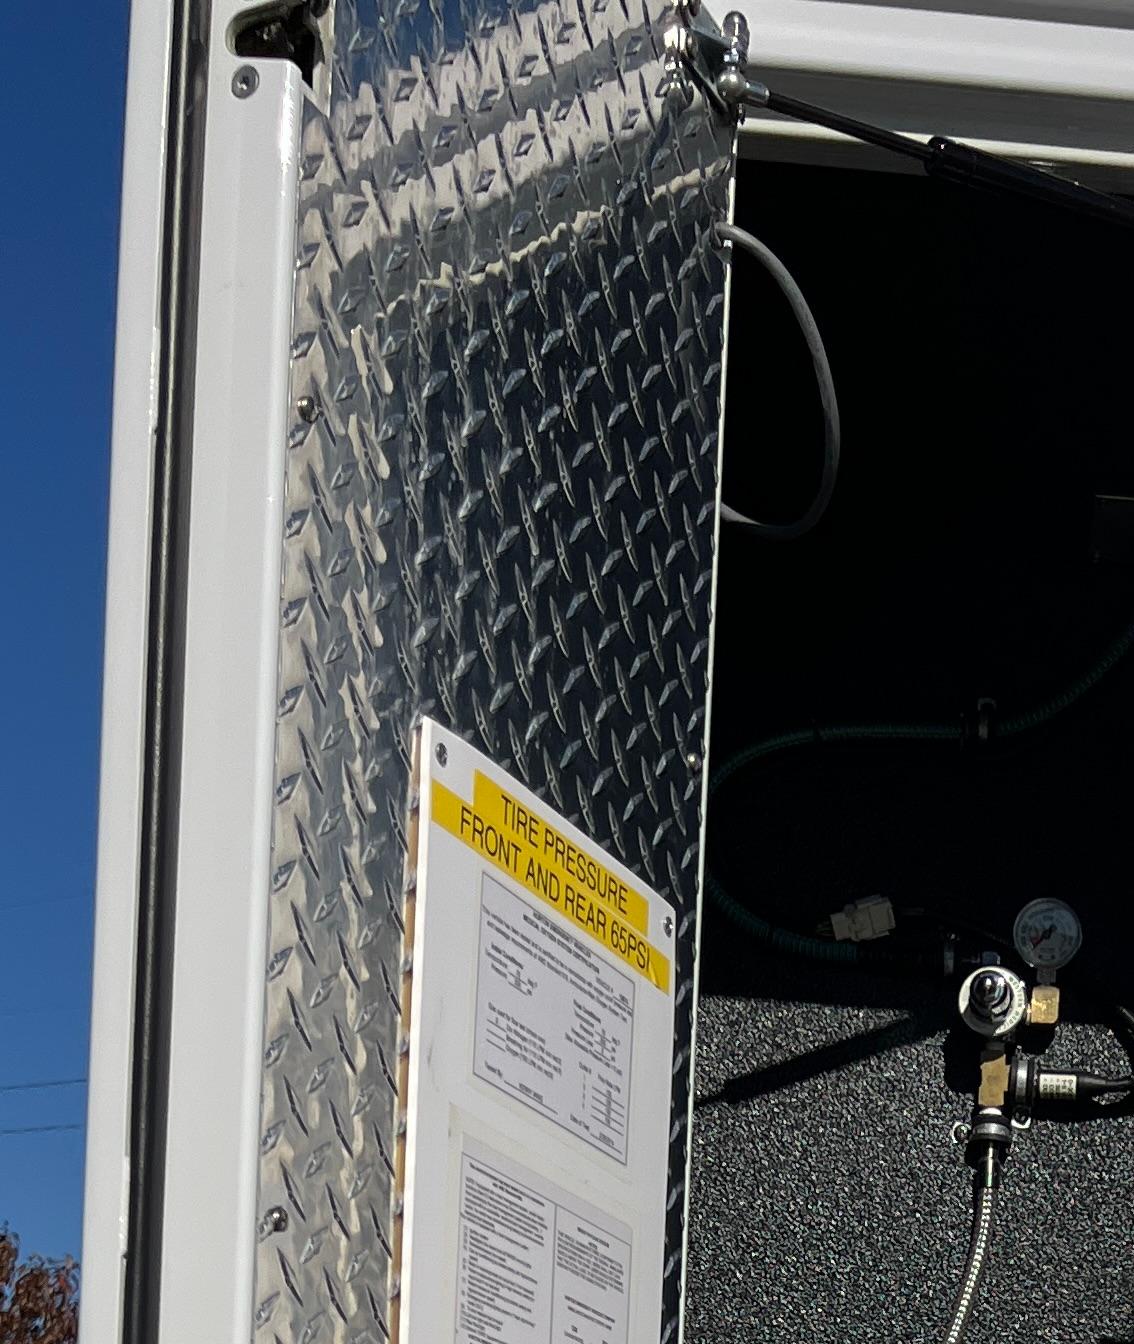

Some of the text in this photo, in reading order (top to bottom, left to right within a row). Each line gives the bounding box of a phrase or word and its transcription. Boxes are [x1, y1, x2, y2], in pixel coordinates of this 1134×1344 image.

[459, 805, 522, 873] FRONT
[525, 857, 560, 903] AND
[564, 884, 607, 940] REAR
[610, 919, 650, 973] 65PSI
[500, 794, 628, 916] TIRE PRESSURE
